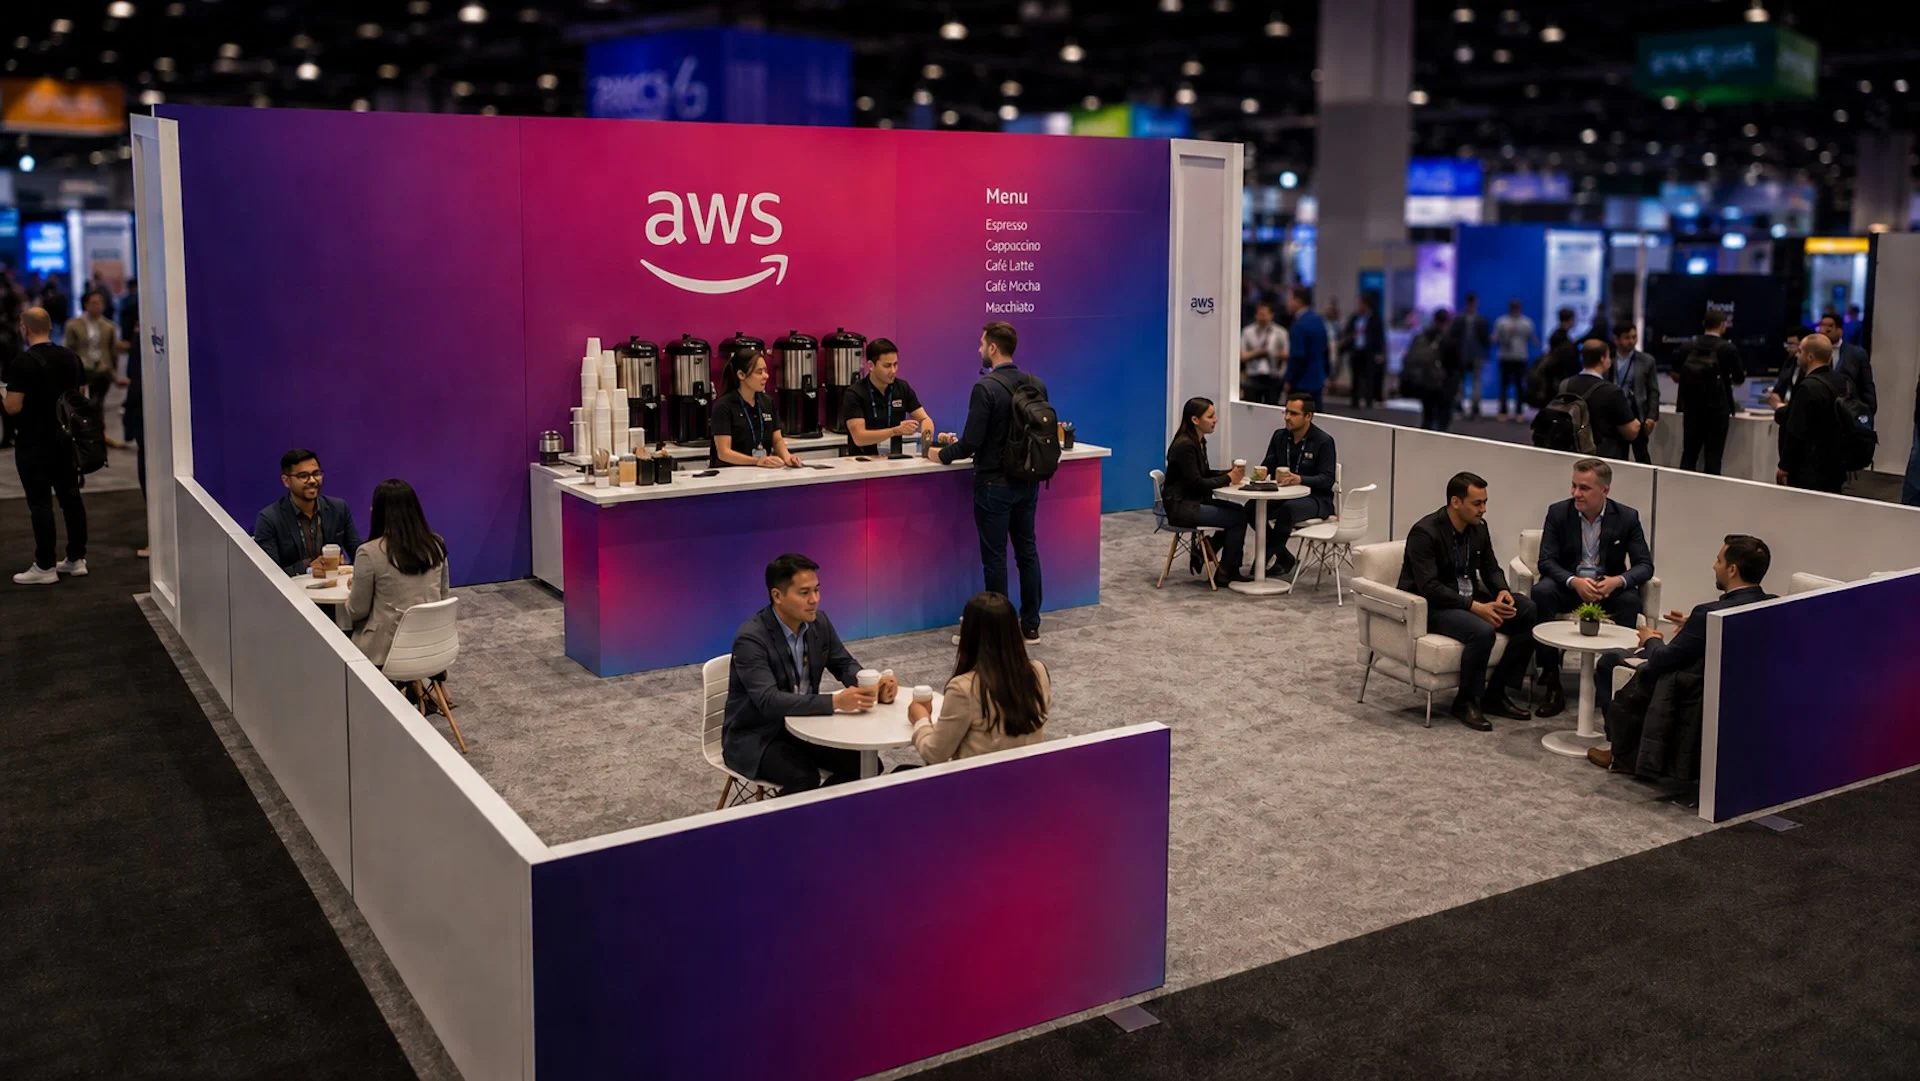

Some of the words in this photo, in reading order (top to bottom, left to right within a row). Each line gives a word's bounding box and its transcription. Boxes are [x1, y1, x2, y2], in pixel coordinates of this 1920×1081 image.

[986, 188, 1029, 205] Menu
[645, 191, 783, 246] aws
[985, 218, 1028, 232] Espresso
[985, 259, 1007, 272] Café
[1009, 259, 1035, 272] Latte
[985, 280, 1007, 293] Café
[1008, 280, 1041, 293] Mocha
[985, 301, 1035, 314] Macchiato
[1190, 297, 1214, 308] aws
